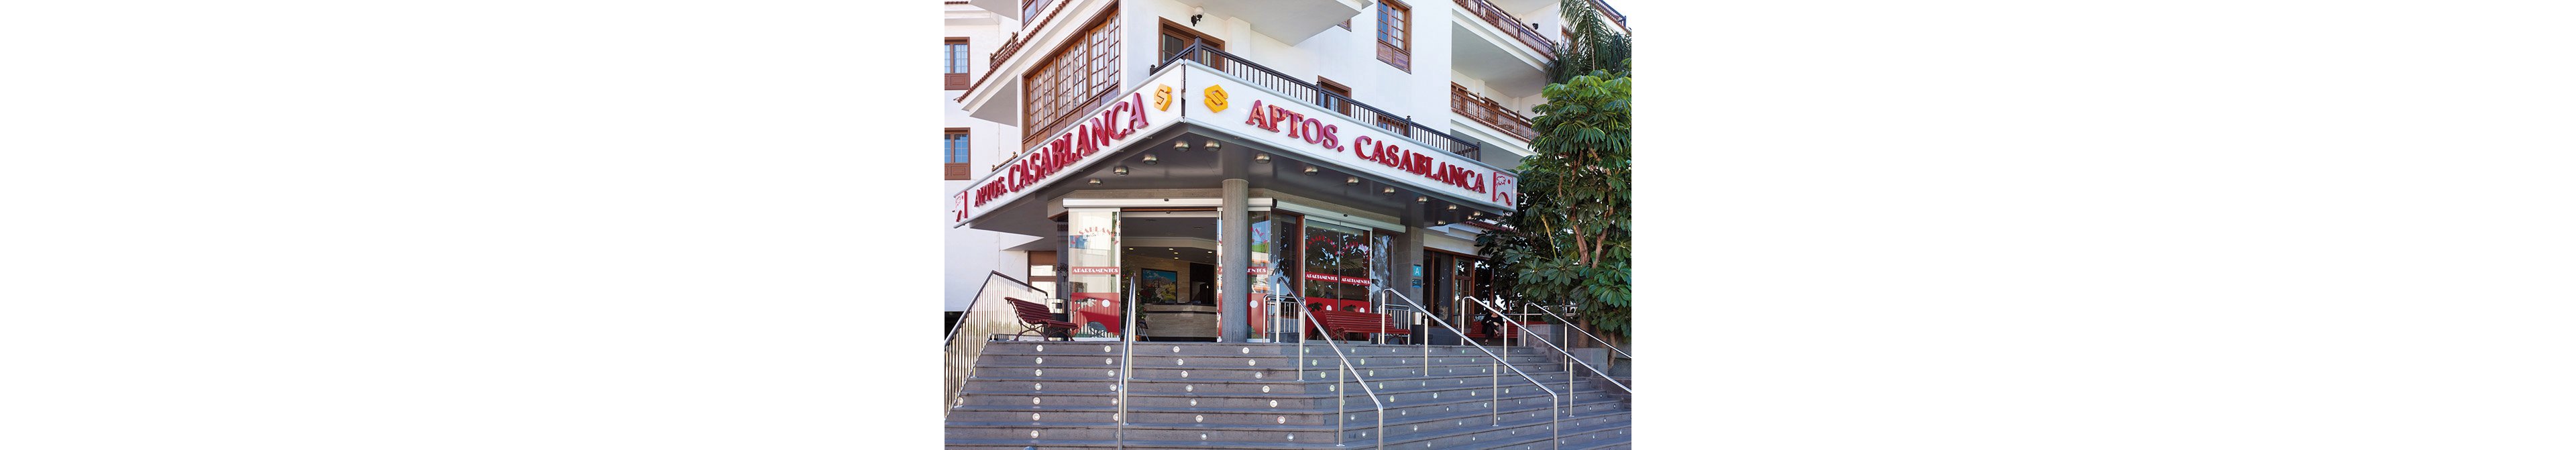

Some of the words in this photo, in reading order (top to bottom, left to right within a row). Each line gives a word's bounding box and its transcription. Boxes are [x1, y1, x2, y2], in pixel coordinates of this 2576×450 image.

[974, 176, 1008, 207] APTOS.
[1008, 92, 1149, 192] CASABLANCA
[1245, 99, 1345, 153] APTOS.
[1354, 135, 1487, 194] CASABLANCA
